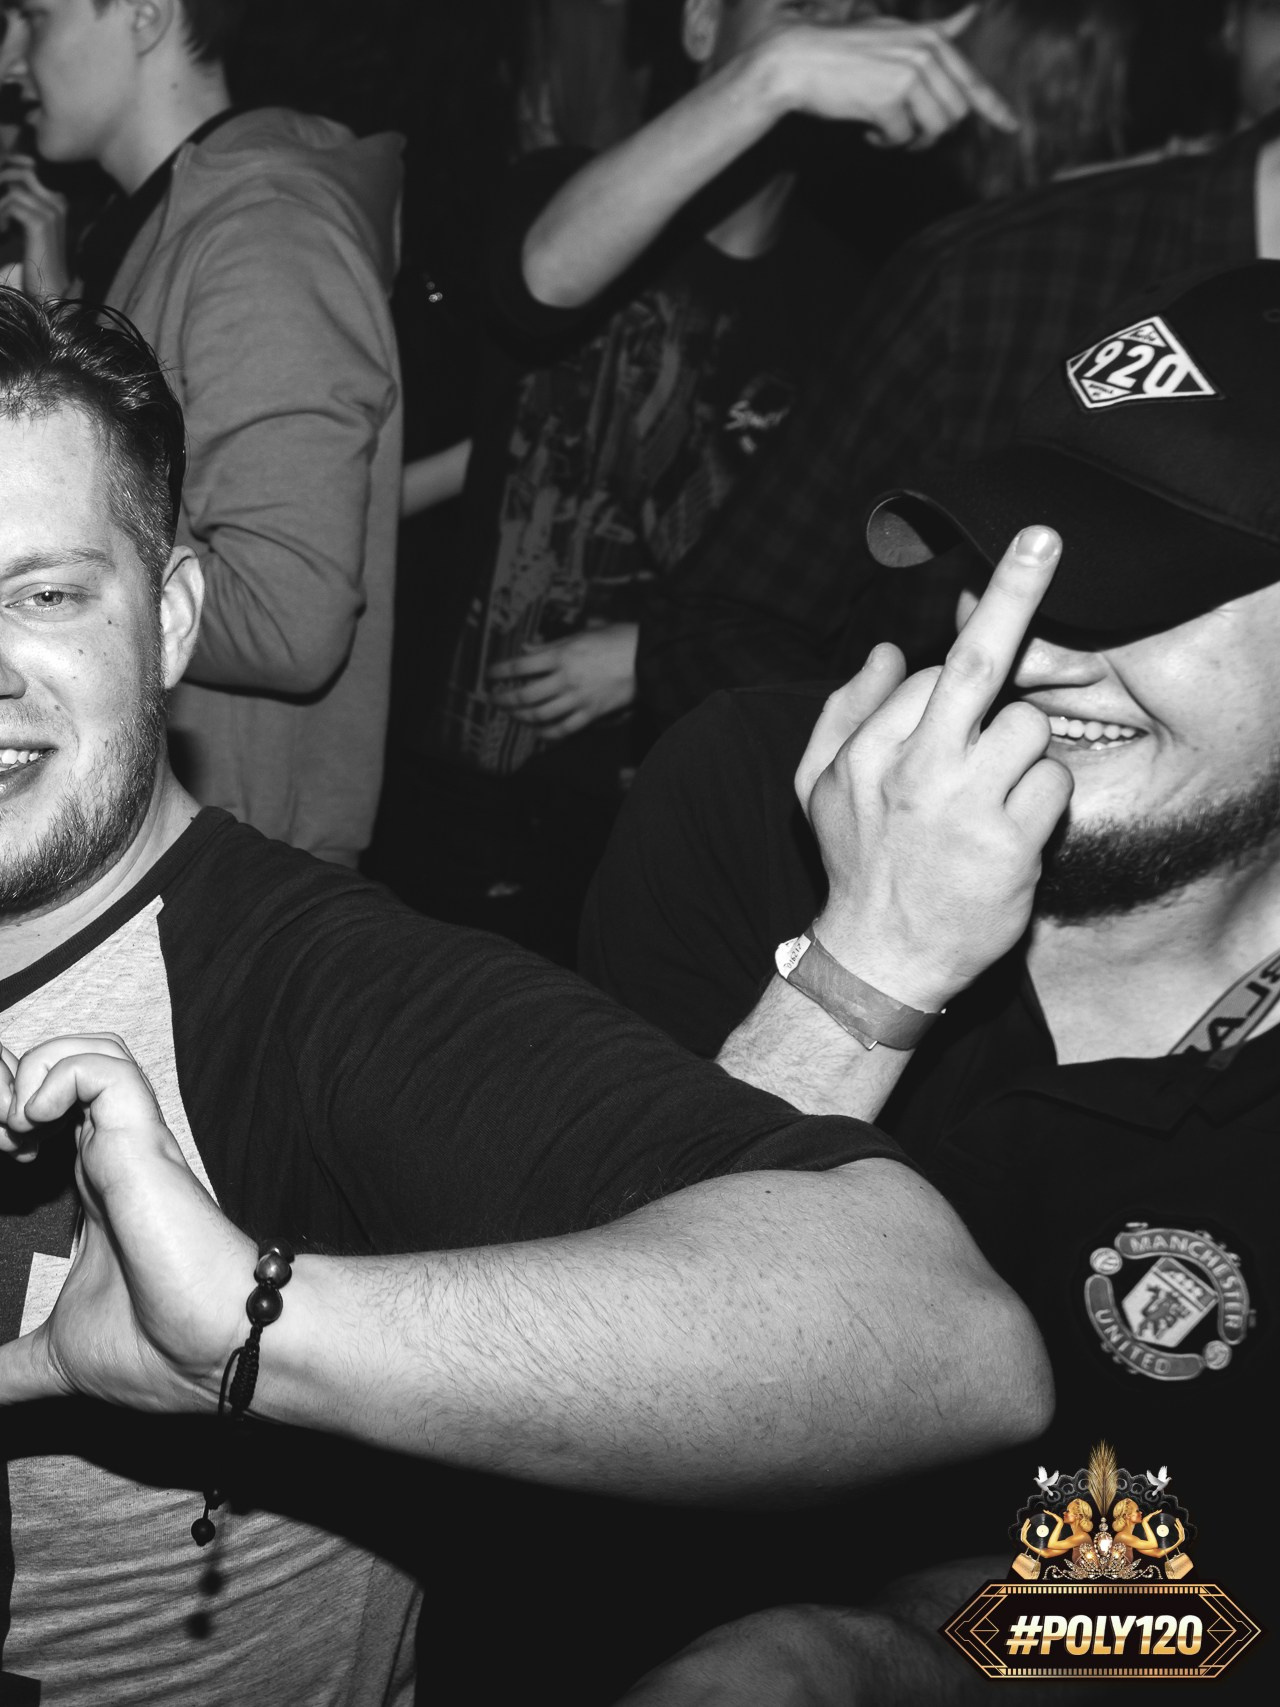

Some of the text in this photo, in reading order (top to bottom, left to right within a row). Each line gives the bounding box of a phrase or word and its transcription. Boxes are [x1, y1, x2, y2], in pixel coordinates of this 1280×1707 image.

[1083, 340, 1187, 394] 920
[1130, 1235, 1243, 1329] MANCHESTER
[1095, 1308, 1170, 1374] UNITED
